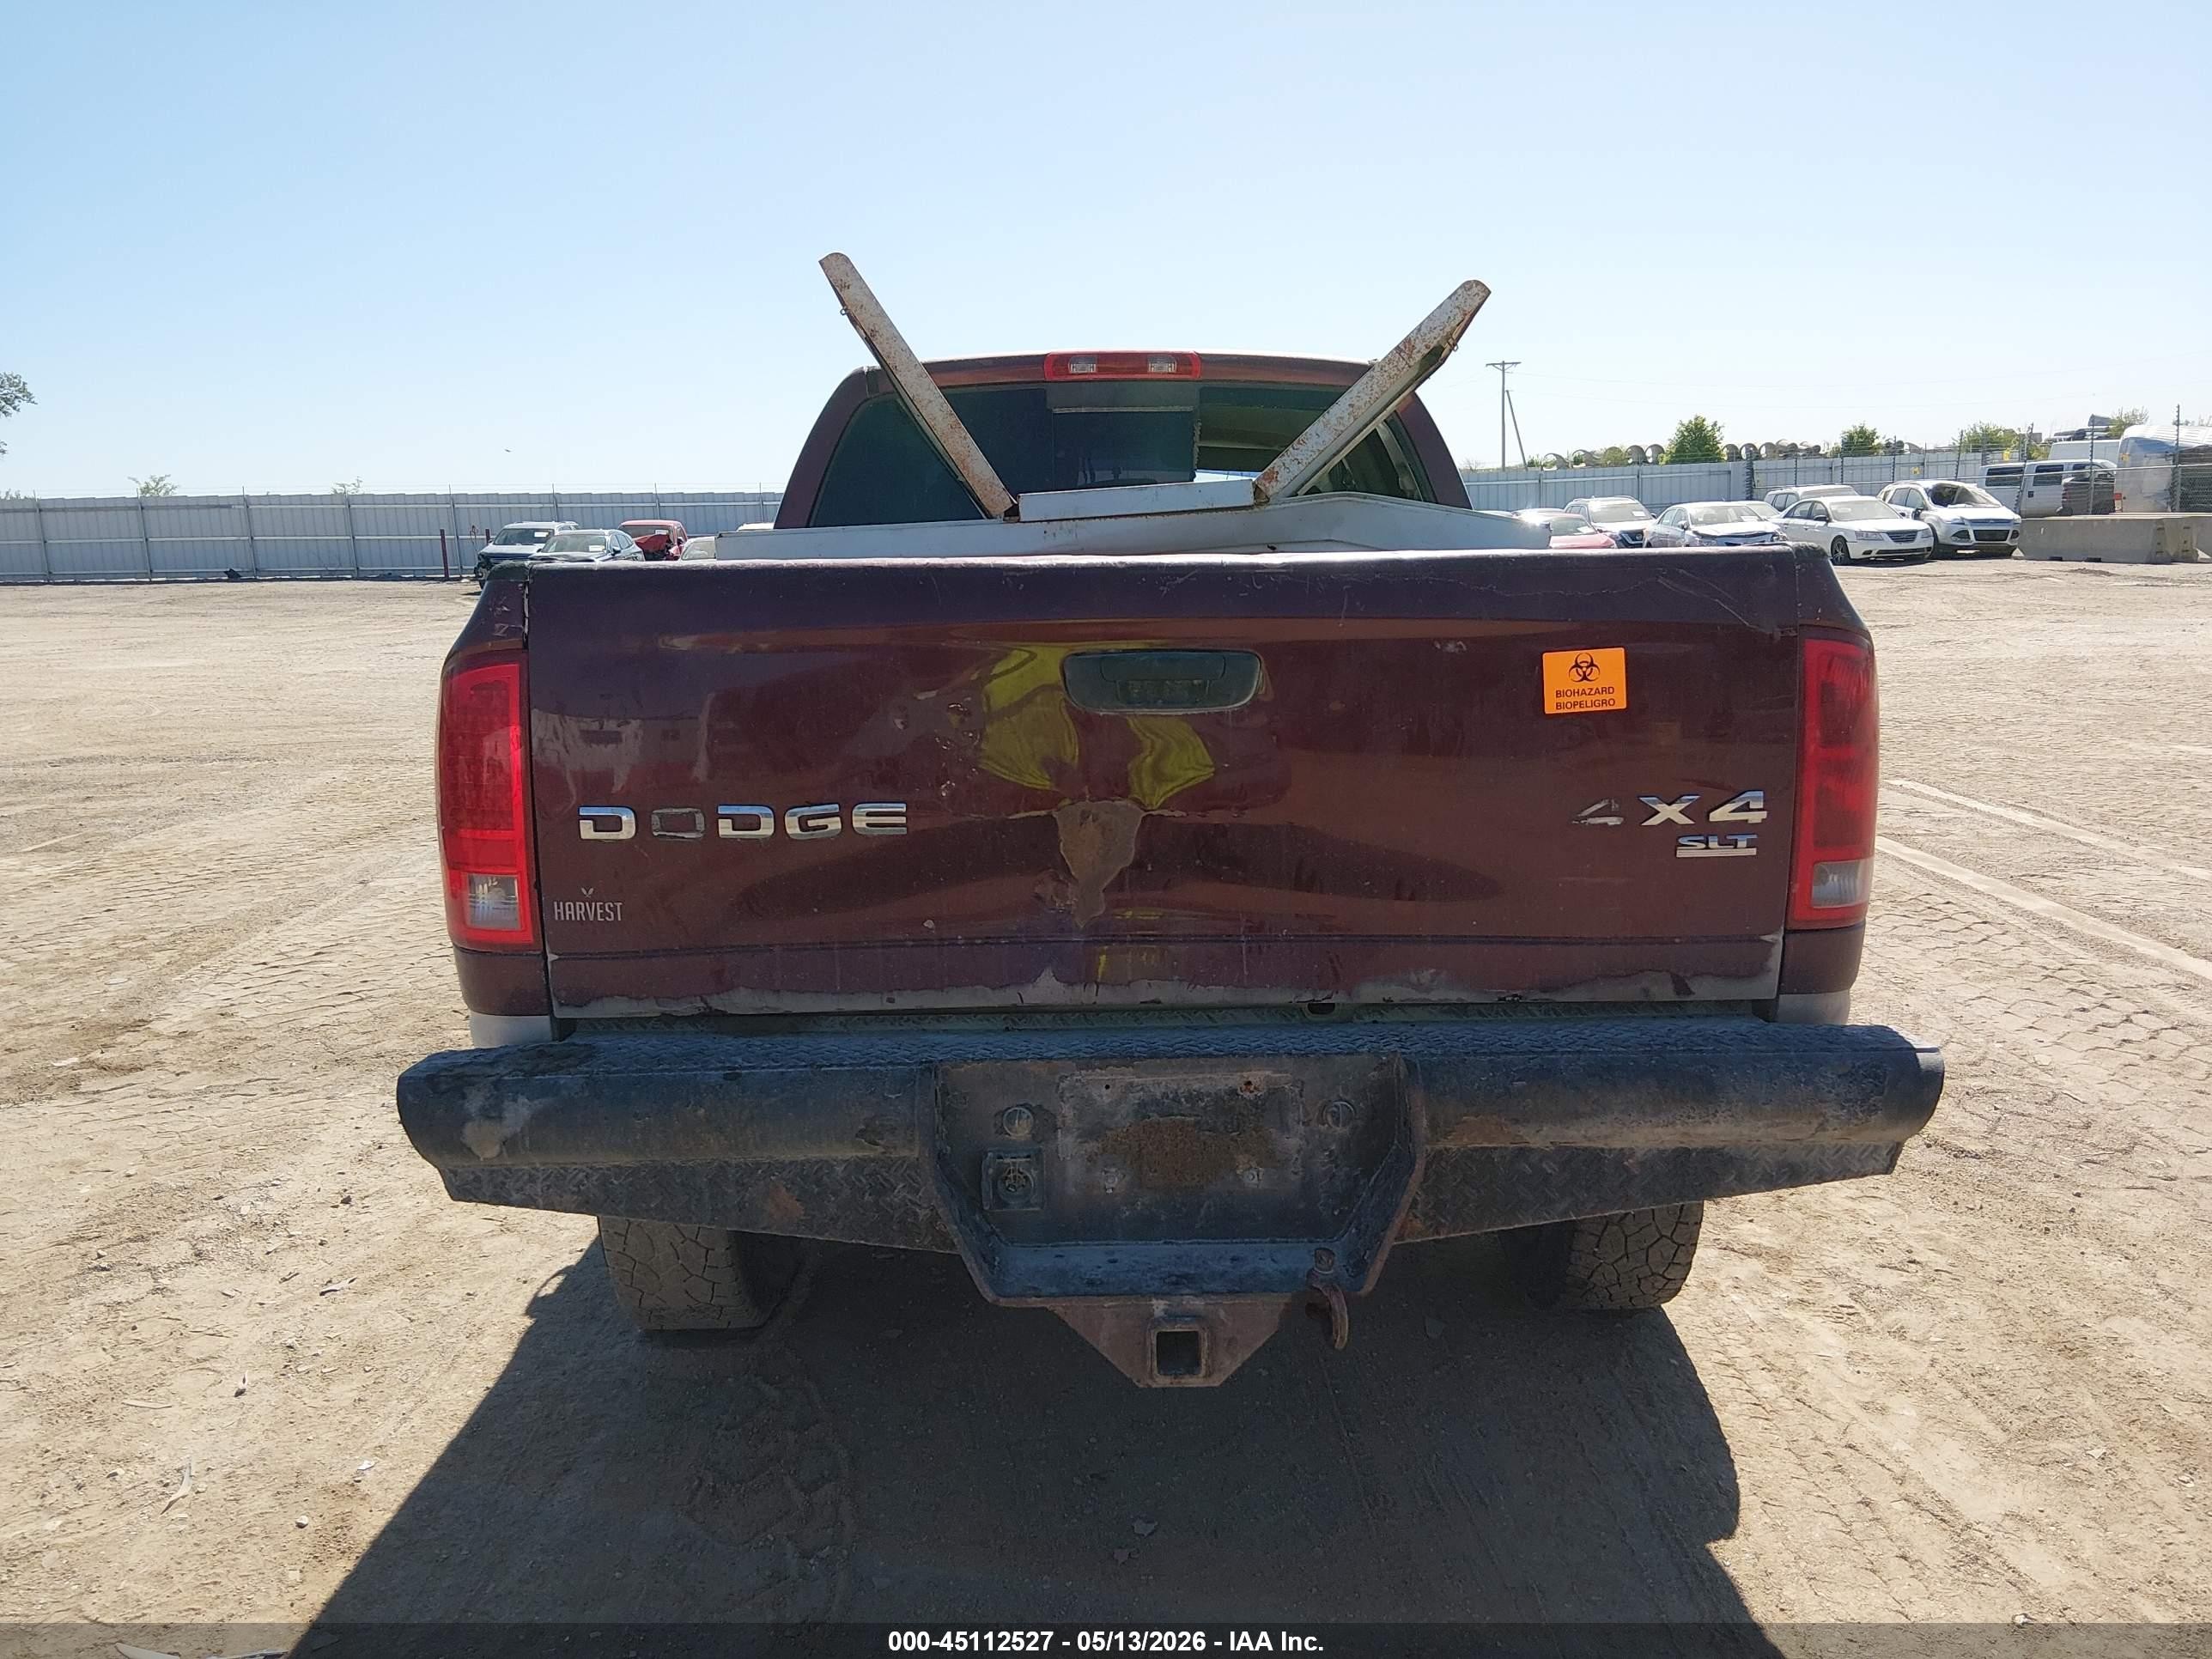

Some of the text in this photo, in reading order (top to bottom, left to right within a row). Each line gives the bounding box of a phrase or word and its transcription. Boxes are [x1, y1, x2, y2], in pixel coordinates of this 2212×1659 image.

[1555, 686, 1614, 698] BIOHAZARD
[1555, 698, 1615, 710] BIOPELIGRO
[579, 803, 908, 841] DODGE
[1677, 833, 1758, 849] SLT
[554, 902, 623, 922] HARVEST
